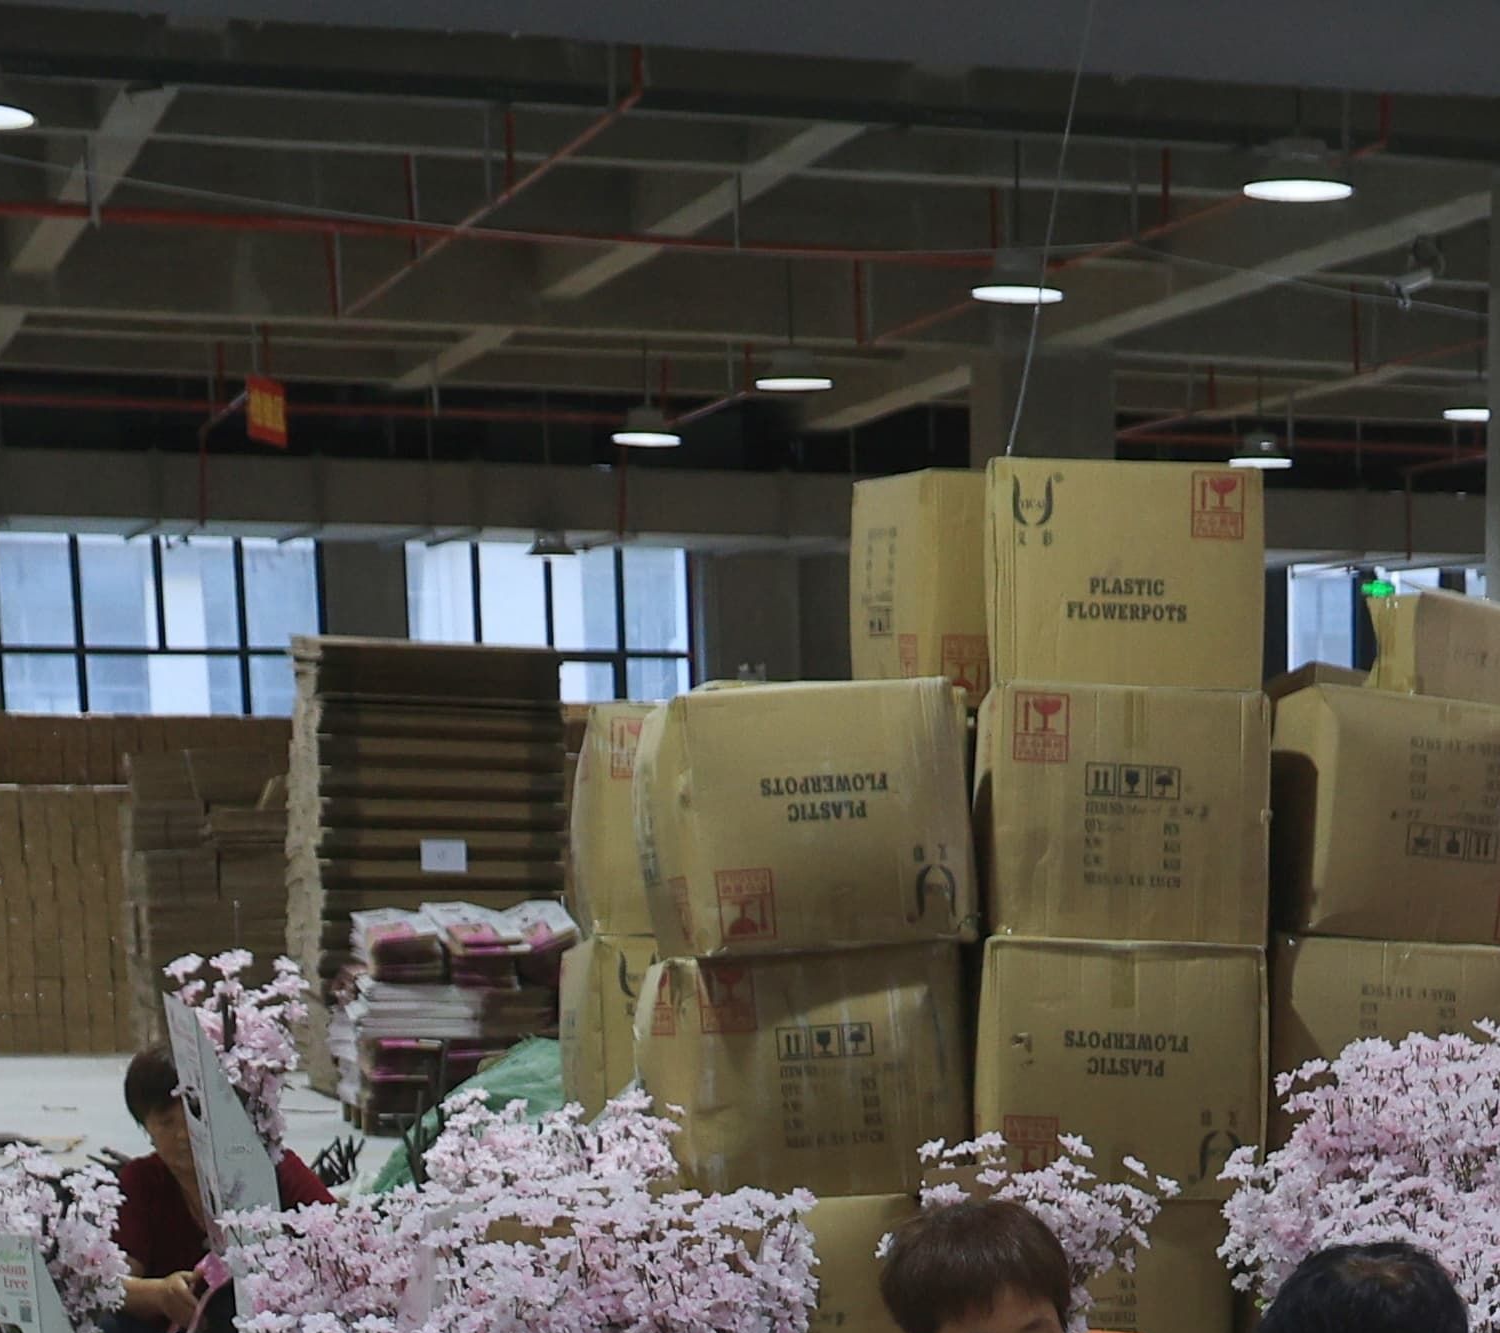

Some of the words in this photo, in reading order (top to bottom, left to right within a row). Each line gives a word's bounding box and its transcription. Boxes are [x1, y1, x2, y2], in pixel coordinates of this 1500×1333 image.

[1089, 577, 1165, 596] PLASTIC
[1066, 601, 1188, 624] FLOWERPOTS
[760, 771, 889, 797] FLOWERPOTS
[787, 800, 868, 822] PLASTIC
[1063, 1030, 1190, 1053] FLOWERPOTS
[1086, 1057, 1166, 1078] PLASTIC
